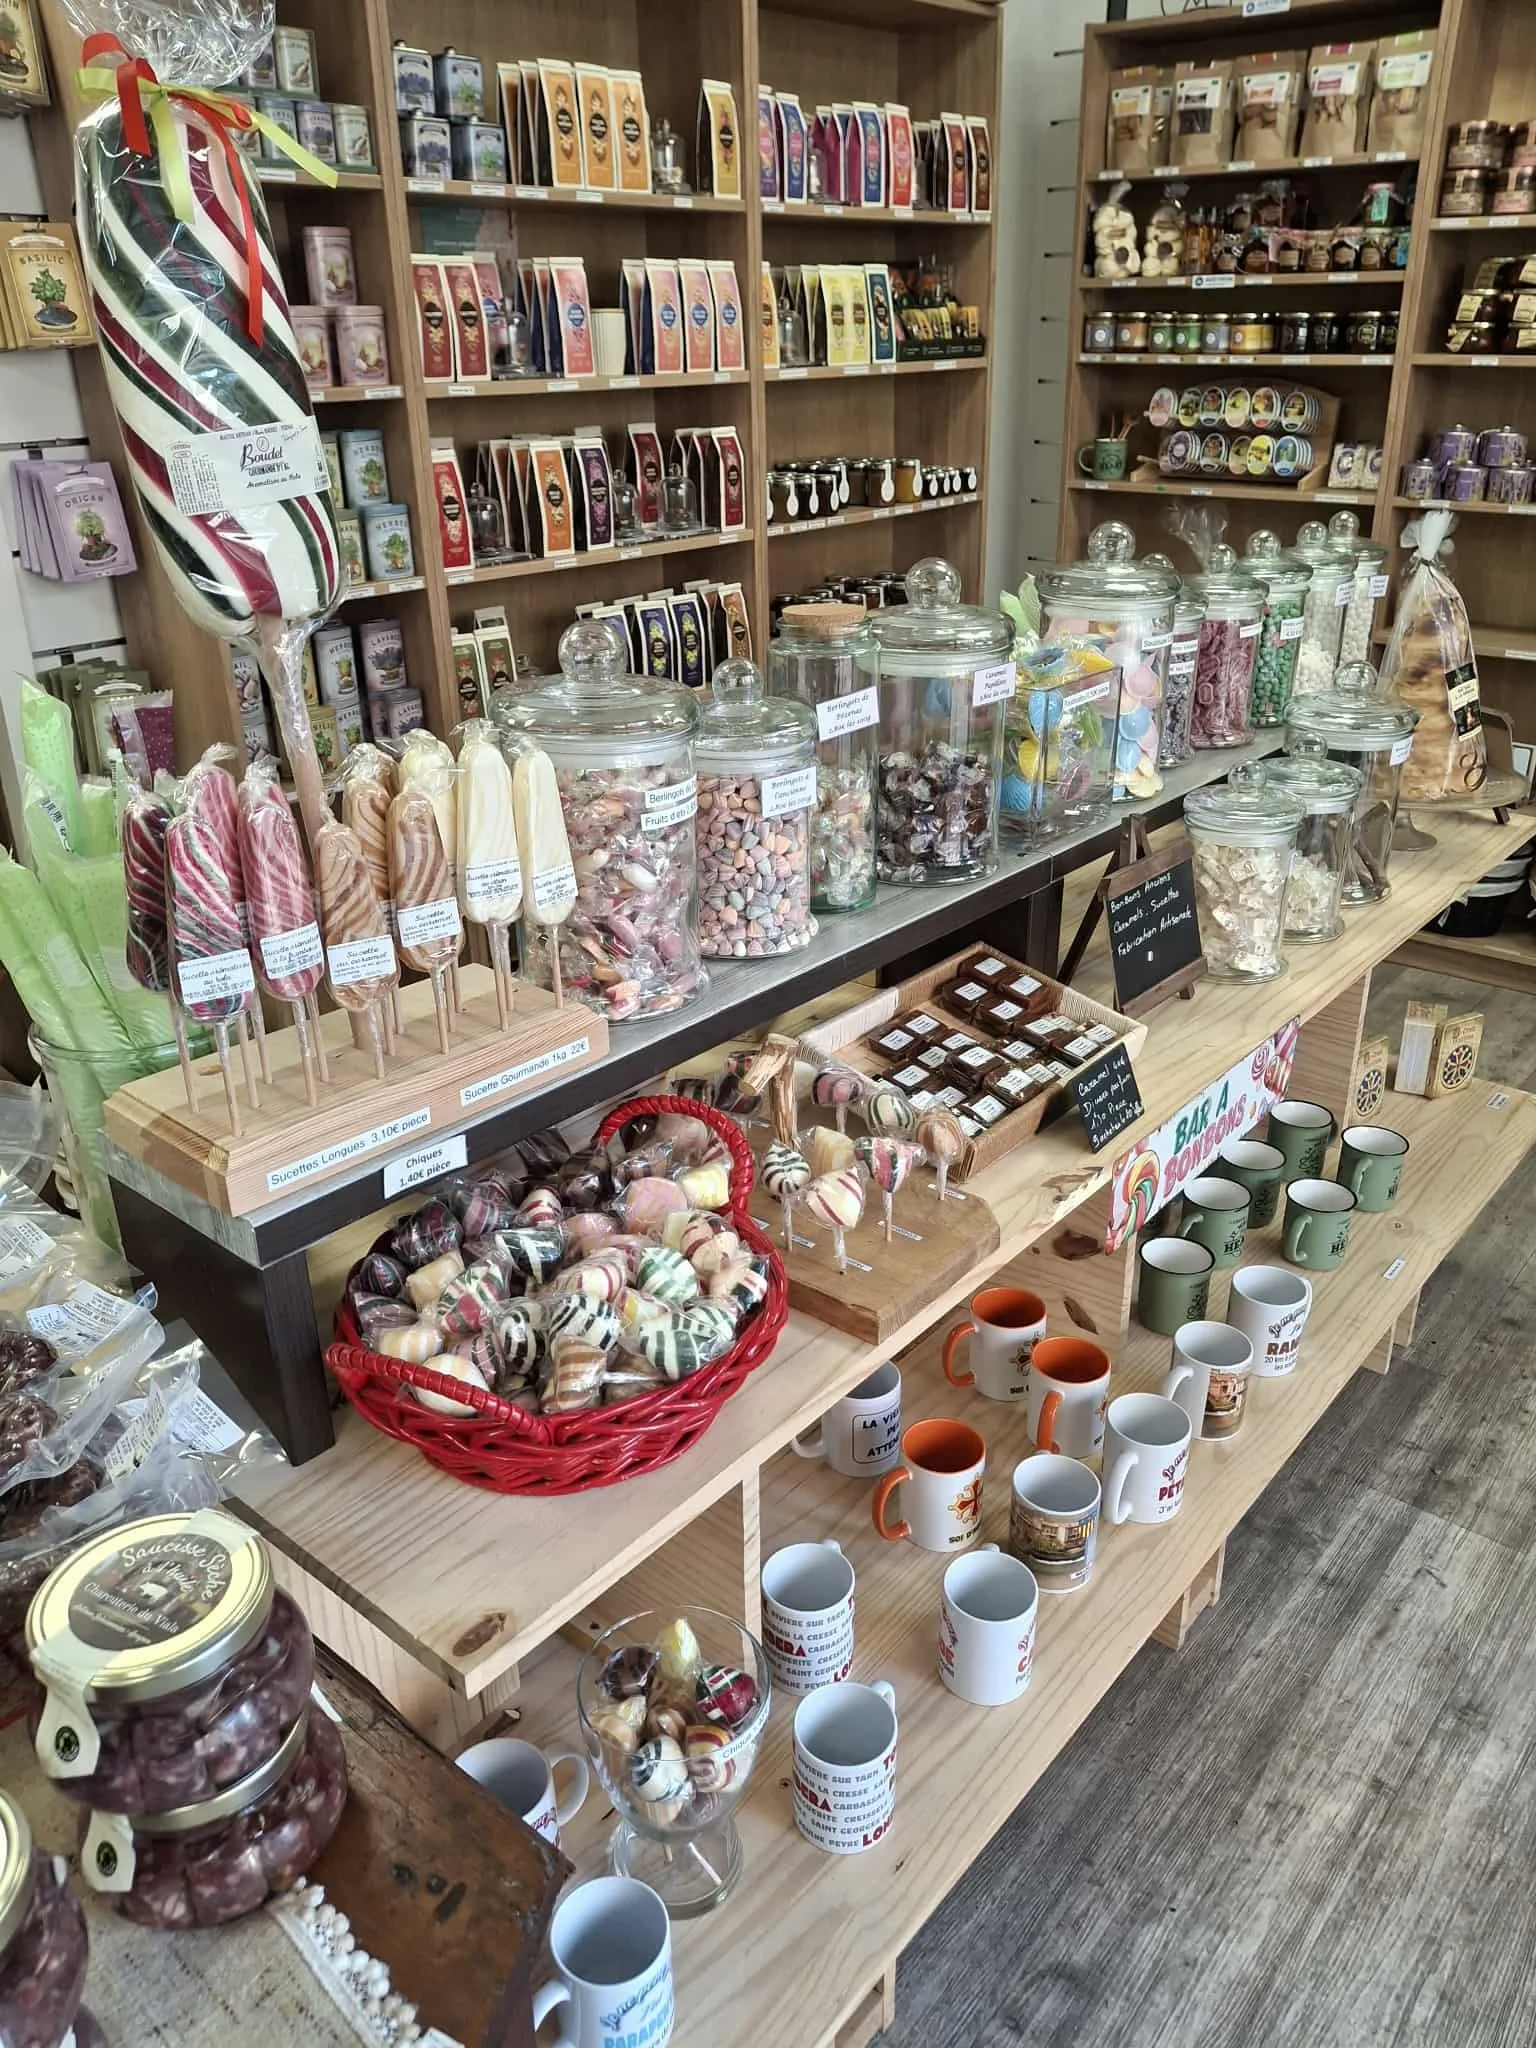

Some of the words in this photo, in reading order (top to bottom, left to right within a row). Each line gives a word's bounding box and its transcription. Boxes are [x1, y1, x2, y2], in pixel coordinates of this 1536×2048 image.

[19, 253, 65, 265] BASILIC
[64, 494, 104, 508] ORIGAN
[1117, 926, 1157, 958] Fabrication
[464, 1079, 499, 1101] Sucette
[500, 1058, 550, 1085] Gourmande
[571, 1040, 586, 1055] 22€
[1078, 1063, 1110, 1097] Caramel
[1174, 1096, 1213, 1156] BAR
[1163, 1093, 1248, 1199] BONBONS
[271, 1158, 319, 1186] Sucettes
[321, 1139, 366, 1165] Longues
[406, 1148, 443, 1169] Chiques
[426, 1160, 451, 1177] pièce
[862, 1419, 878, 1430] LA
[121, 1538, 206, 1567] Saucisse
[199, 1552, 227, 1601] Sèche
[84, 1581, 139, 1616] Charcuterie
[805, 1619, 824, 1628] SUR
[826, 1607, 846, 1622] TARN
[793, 1633, 804, 1641] LA
[807, 1627, 838, 1641] CRESSE
[786, 1666, 813, 1677] SAINT
[831, 1775, 853, 1784] SUR
[855, 1768, 880, 1782] TARN
[819, 1785, 830, 1795] LA
[832, 1786, 870, 1798] CRESSE
[811, 1818, 837, 1833] SAINT
[828, 1839, 860, 1848] PEYRE
